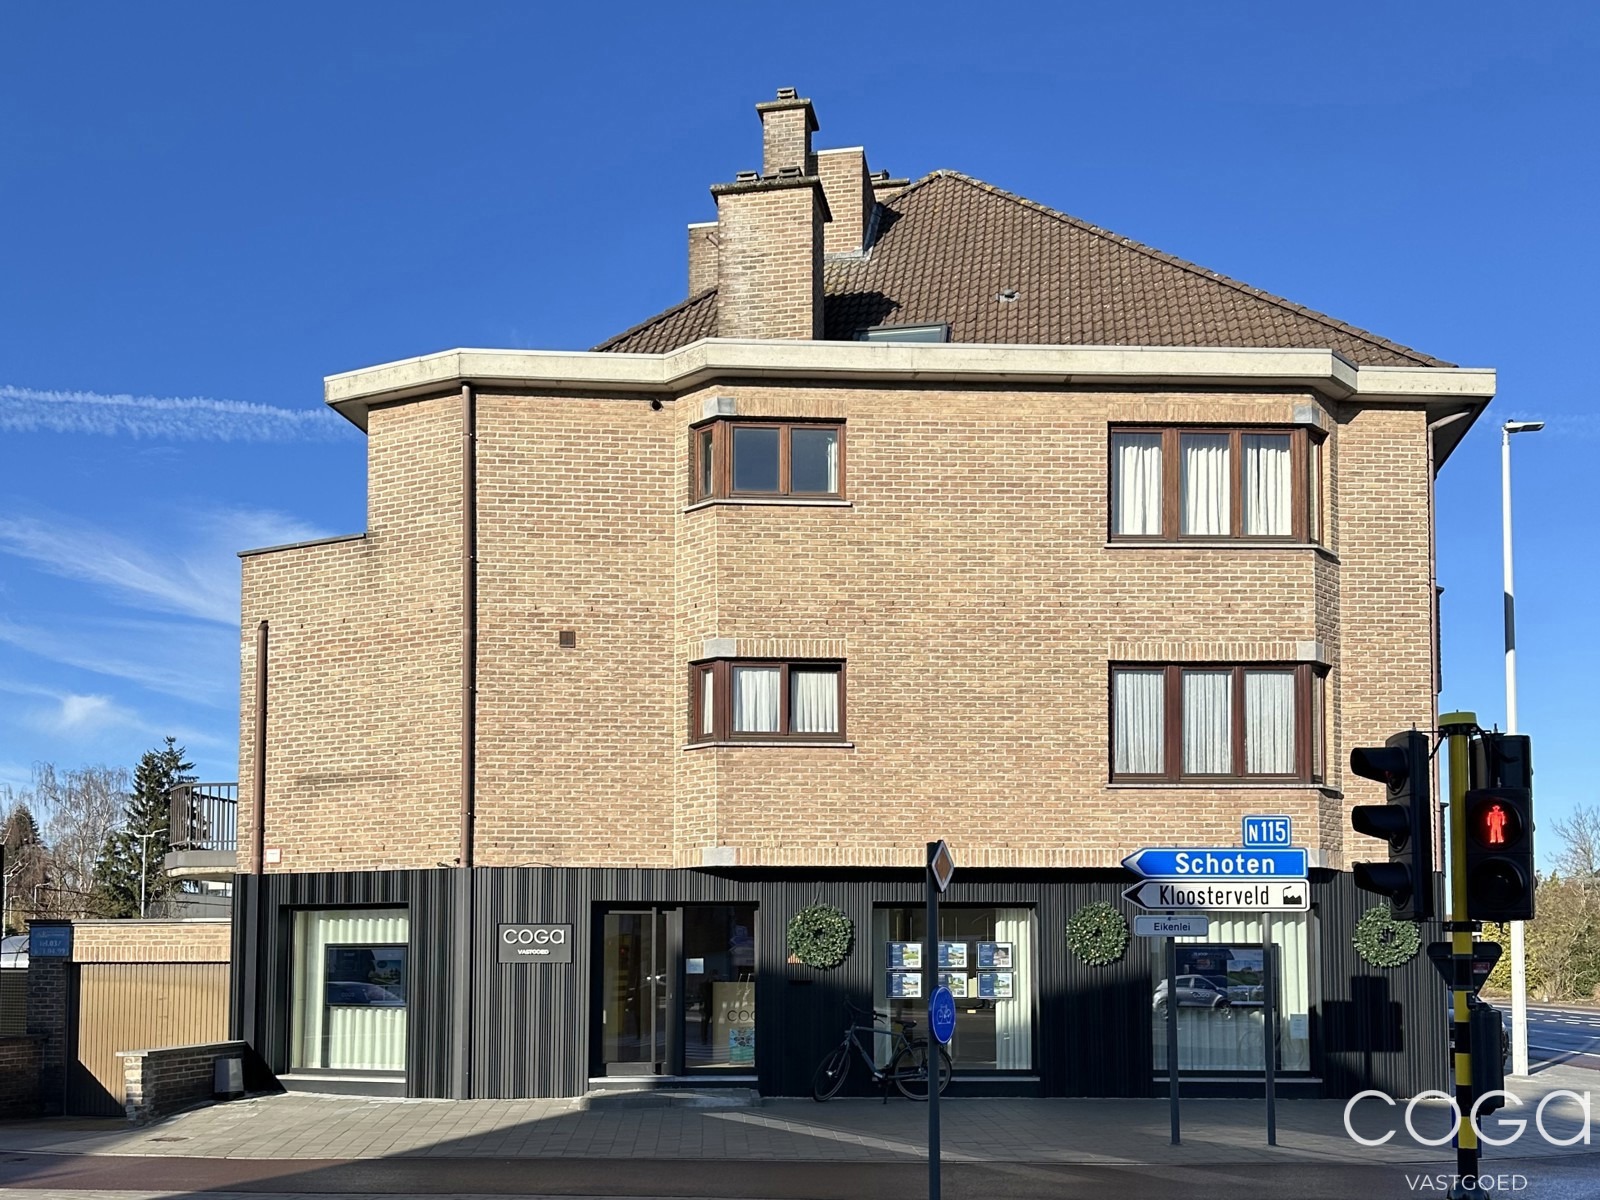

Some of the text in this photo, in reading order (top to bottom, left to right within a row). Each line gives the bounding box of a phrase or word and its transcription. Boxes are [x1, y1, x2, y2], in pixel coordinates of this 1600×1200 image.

[1249, 821, 1286, 842] N115
[1175, 853, 1275, 874] Schoten
[1159, 885, 1269, 905] Kloosterveld
[1153, 922, 1191, 932] Eikenlei
